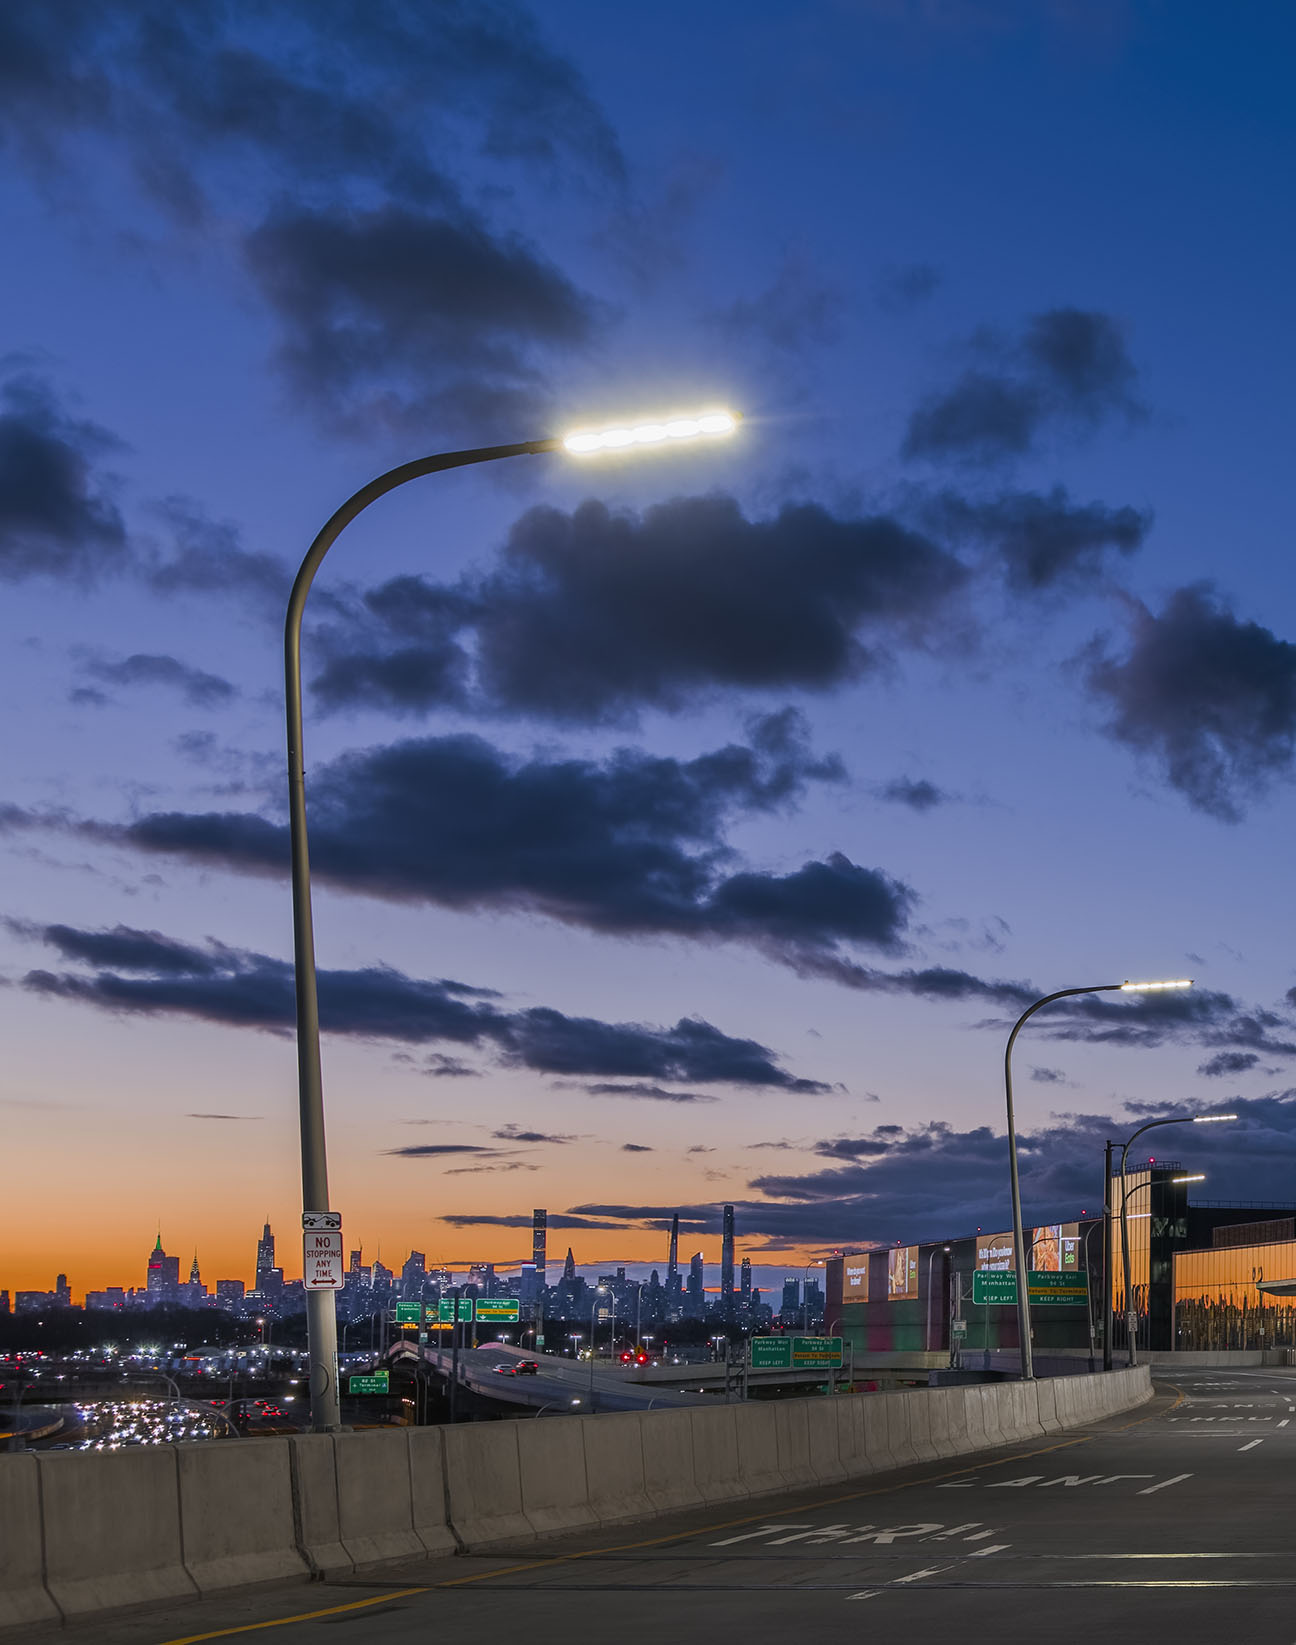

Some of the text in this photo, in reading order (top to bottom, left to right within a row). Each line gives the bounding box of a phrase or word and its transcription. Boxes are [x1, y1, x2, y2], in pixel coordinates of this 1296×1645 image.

[315, 1236, 331, 1248] NO
[1065, 1240, 1075, 1252] Uber
[306, 1250, 341, 1258] STOPPING
[1065, 1253, 1075, 1264] Eats
[316, 1260, 331, 1268] ANY
[315, 1269, 332, 1278] TIME
